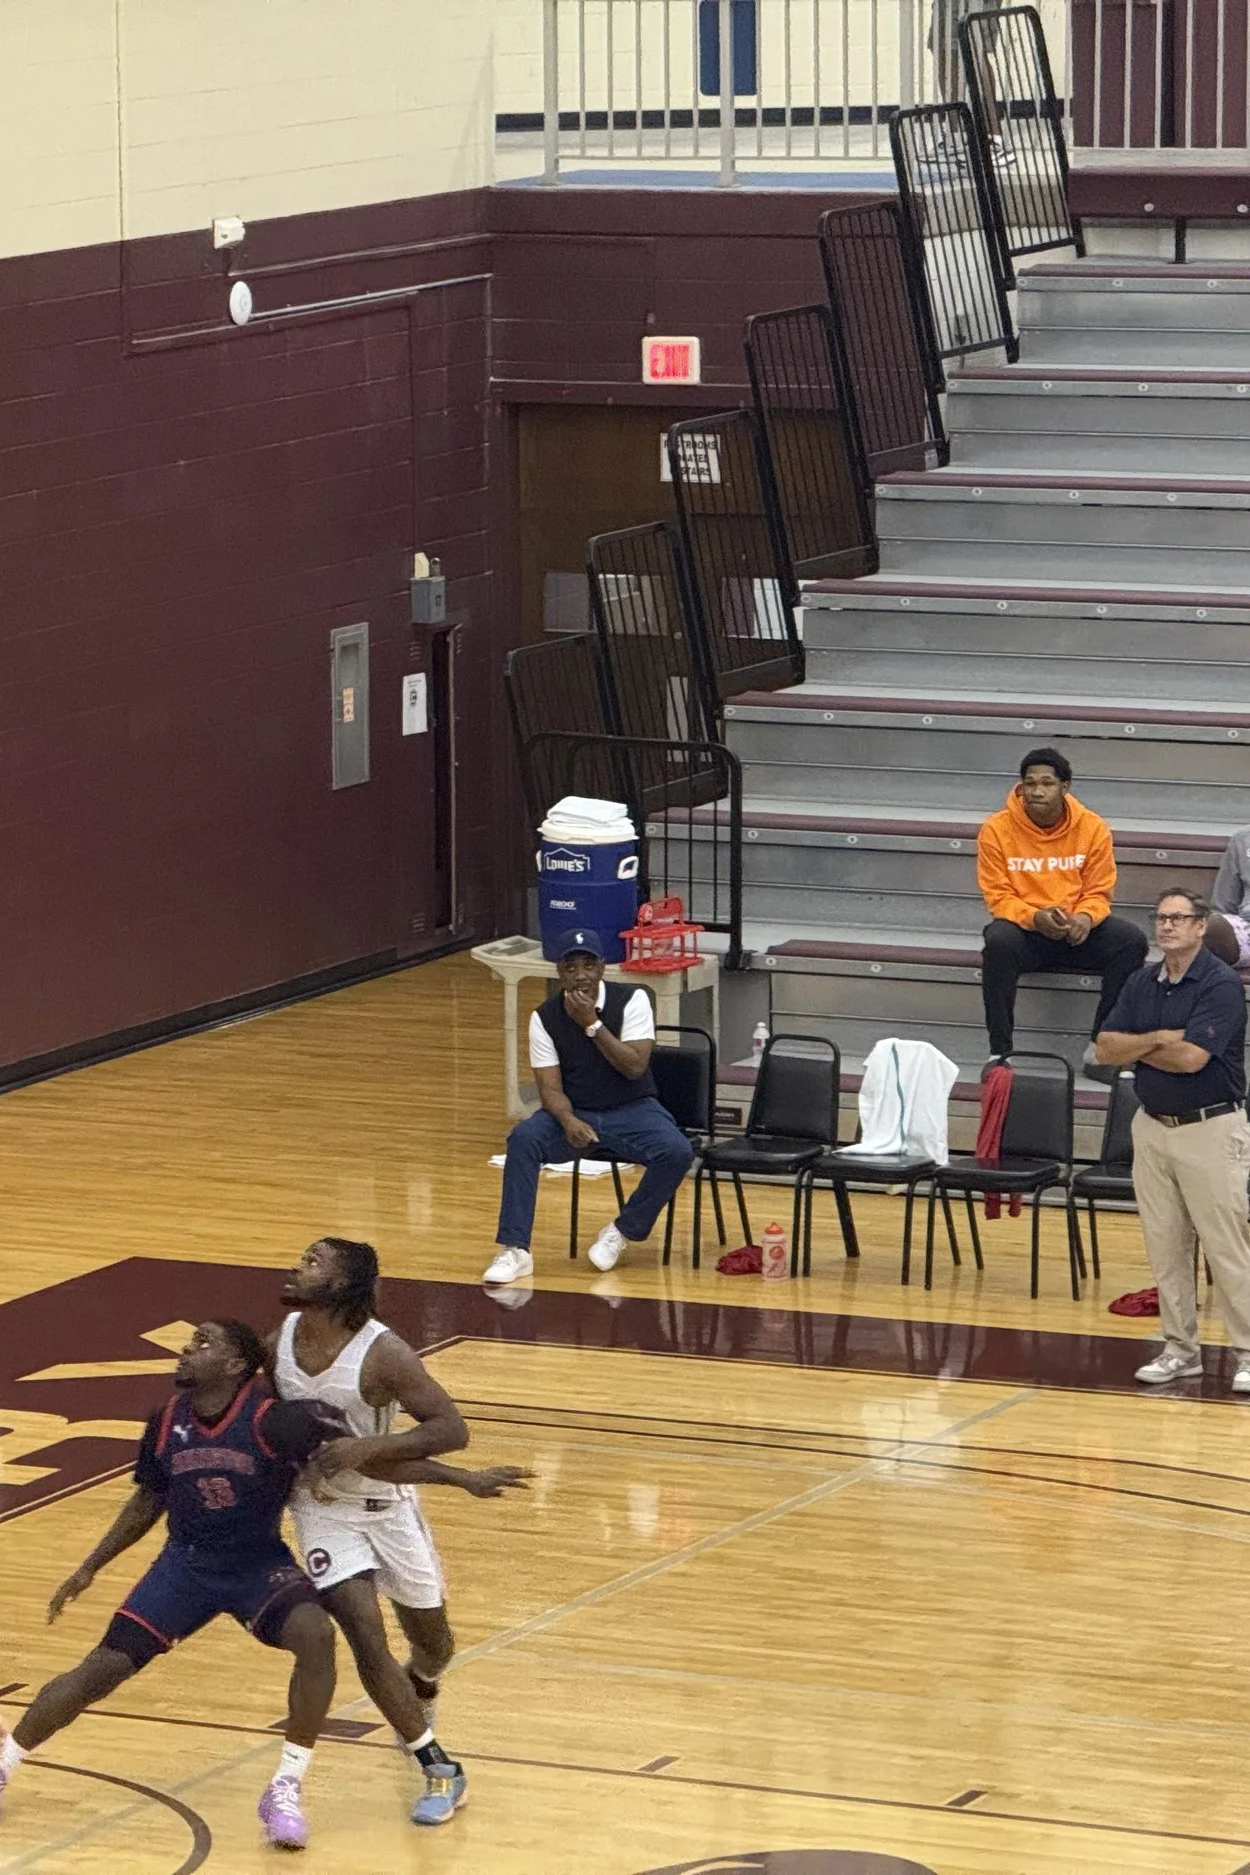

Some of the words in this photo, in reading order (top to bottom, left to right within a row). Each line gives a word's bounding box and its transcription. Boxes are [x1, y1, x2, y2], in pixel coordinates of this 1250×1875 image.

[546, 858, 586, 872] LOWE'S
[1007, 857, 1044, 872] STAY
[309, 1551, 328, 1574] C
